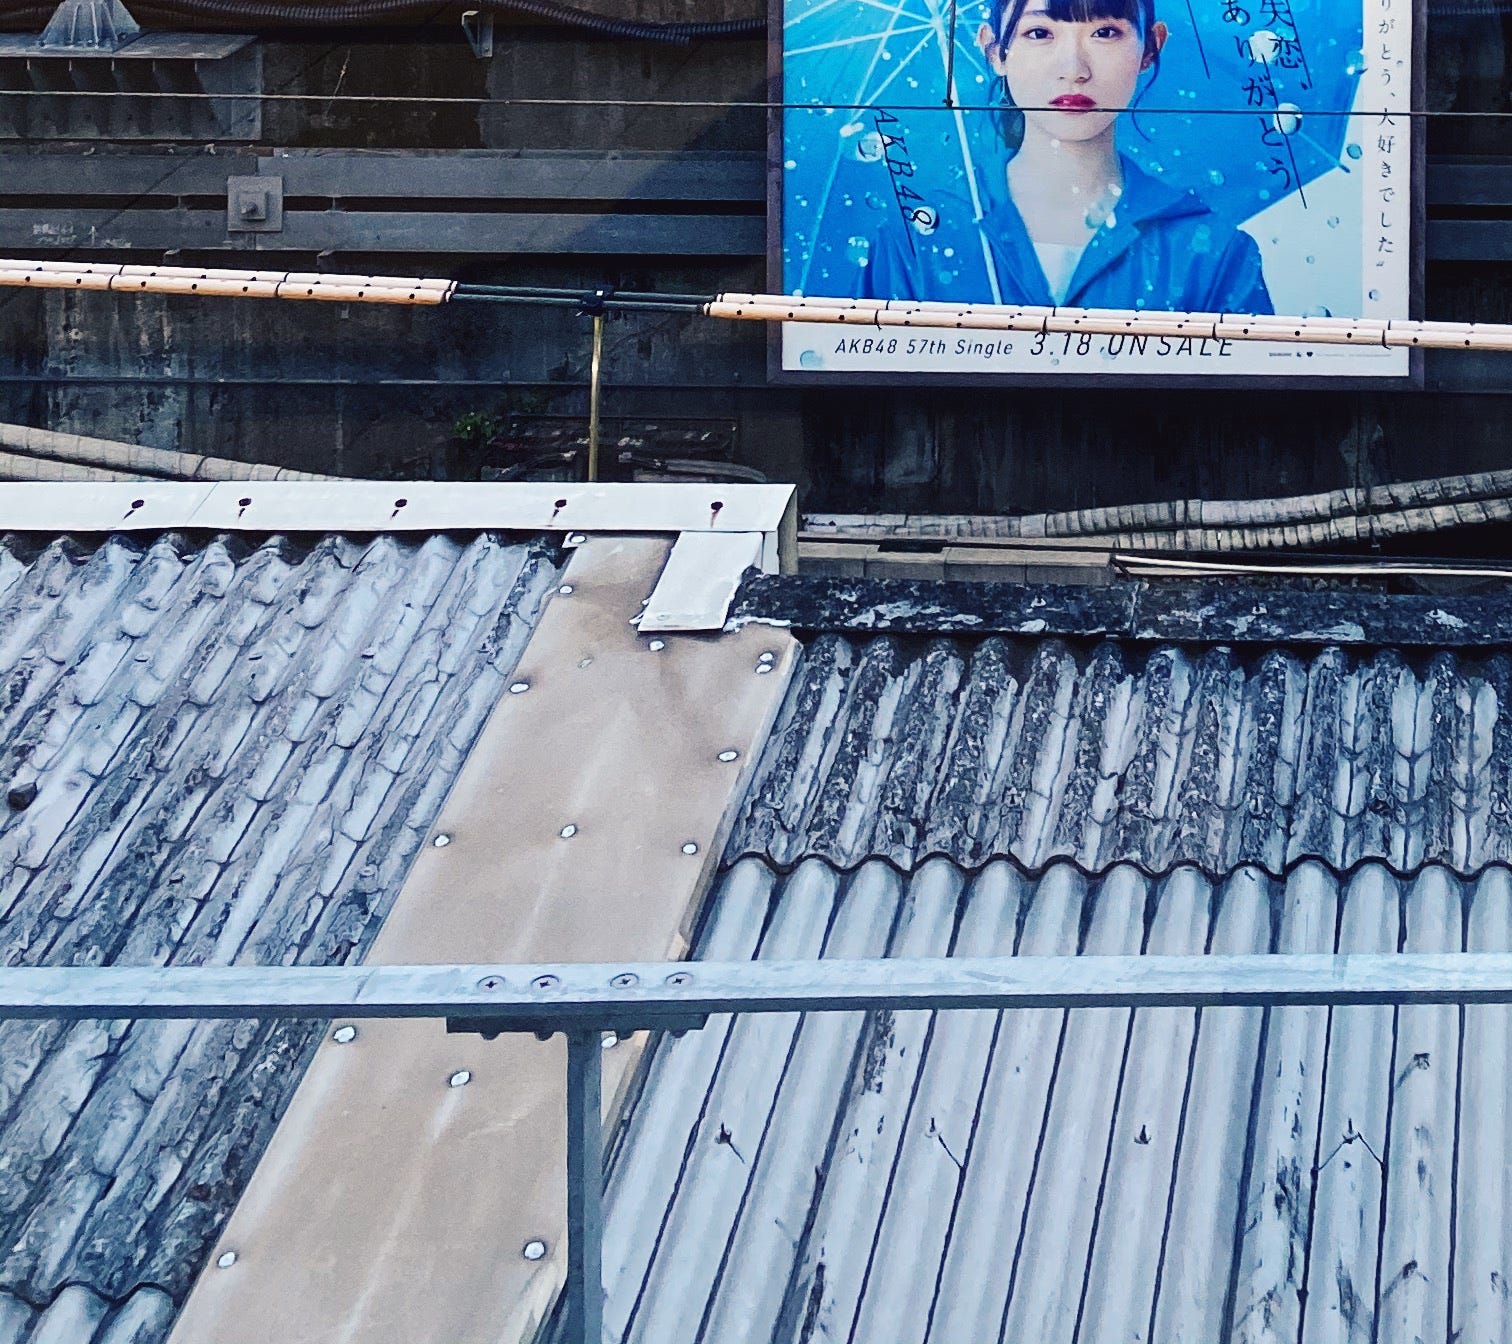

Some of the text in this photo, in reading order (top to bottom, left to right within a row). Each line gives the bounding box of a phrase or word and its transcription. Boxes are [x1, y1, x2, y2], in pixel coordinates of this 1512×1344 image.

[874, 109, 933, 226] AKB48
[834, 331, 1233, 358] AKB48 57th Single 3.18 ON SALE
